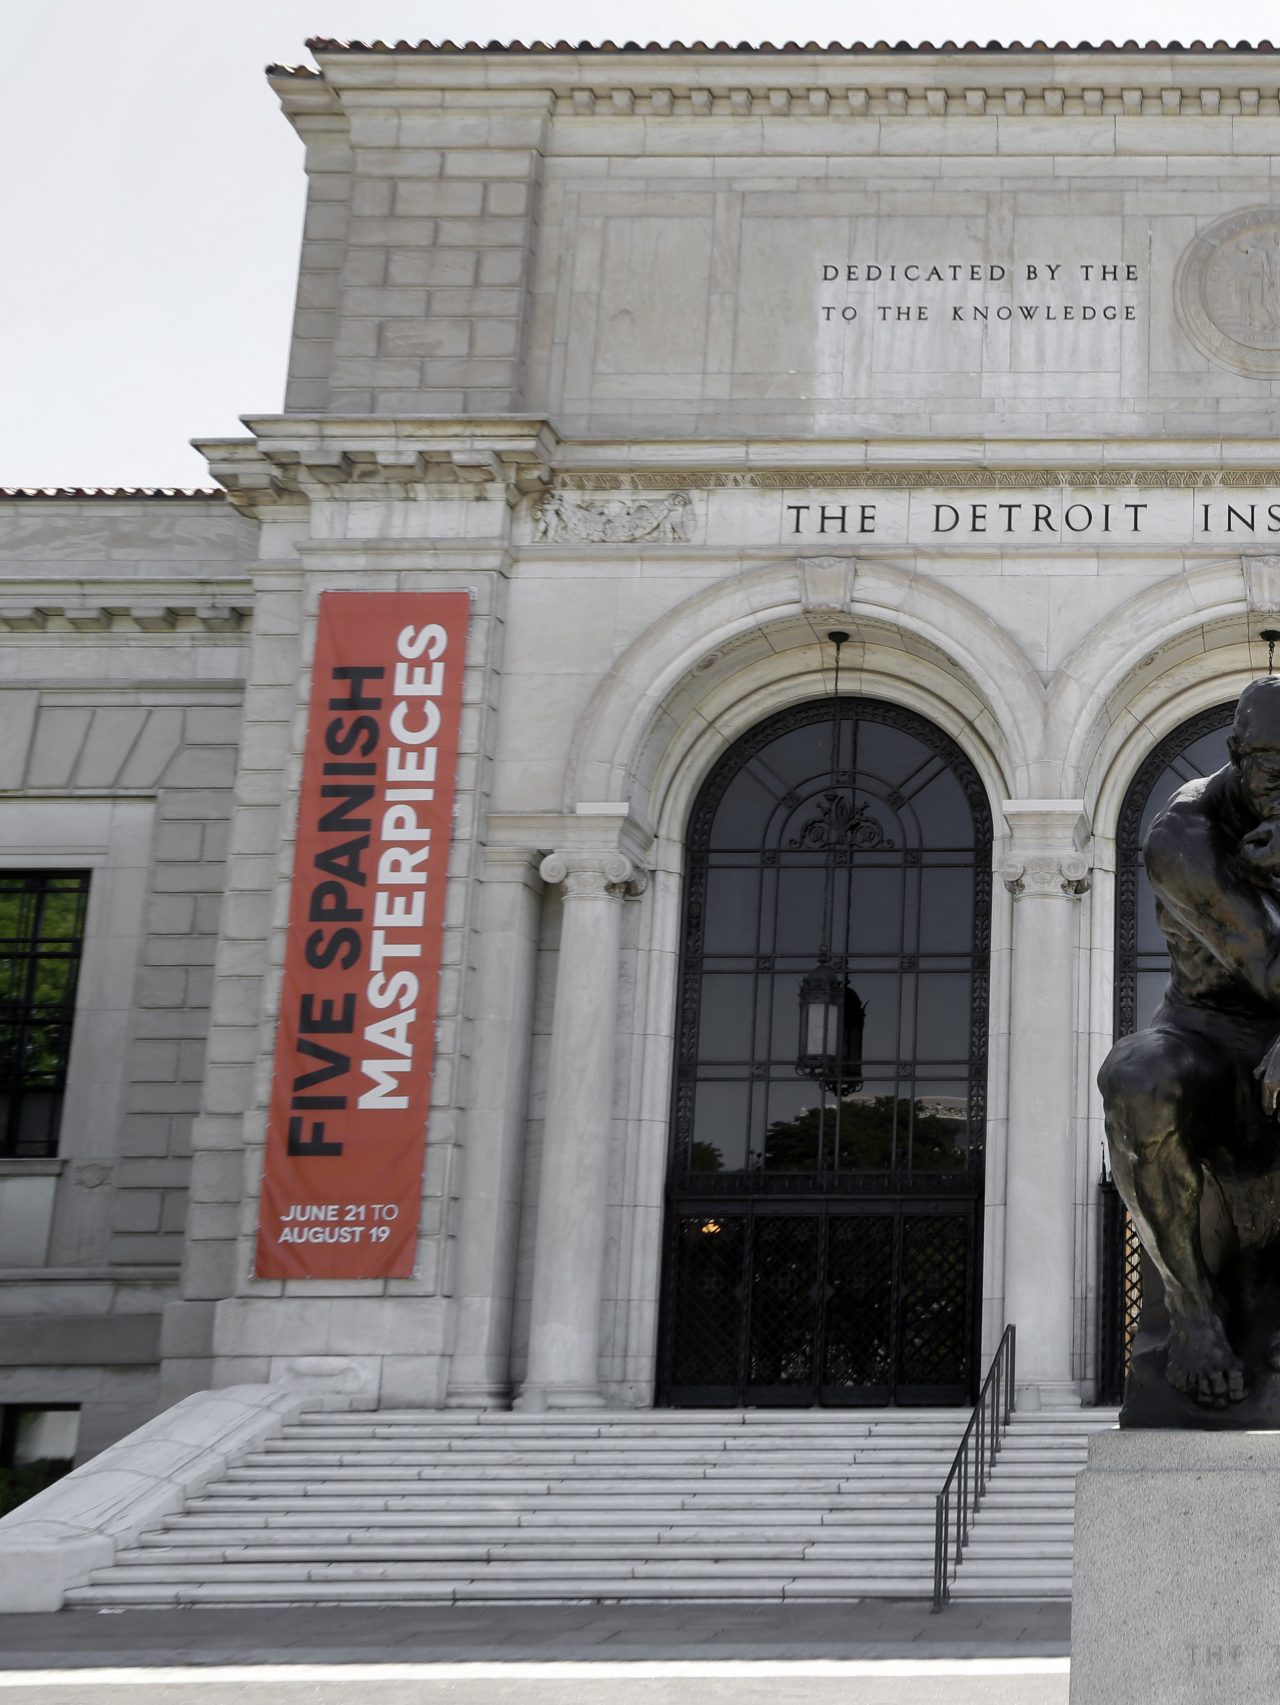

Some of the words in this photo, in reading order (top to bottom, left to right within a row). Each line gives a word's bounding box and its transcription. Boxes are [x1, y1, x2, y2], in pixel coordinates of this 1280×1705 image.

[821, 264, 1006, 282] DEDICATED
[1025, 264, 1062, 281] BY
[1080, 264, 1139, 281] THE
[821, 305, 858, 322] TO
[877, 305, 930, 321] THE
[951, 305, 1137, 322] KNOWLEDGE
[786, 503, 877, 534] THE
[932, 503, 1149, 533] DETROIT
[304, 665, 386, 972] SPANISH
[357, 622, 449, 1110] MASTERPIECES
[286, 992, 358, 1157] FIVE
[279, 1204, 339, 1222] JUNE
[343, 1204, 366, 1222] 21
[370, 1204, 399, 1221] TO
[277, 1226, 366, 1244] AUGUST
[368, 1226, 391, 1243] 19
[1185, 1644, 1243, 1667] THE
